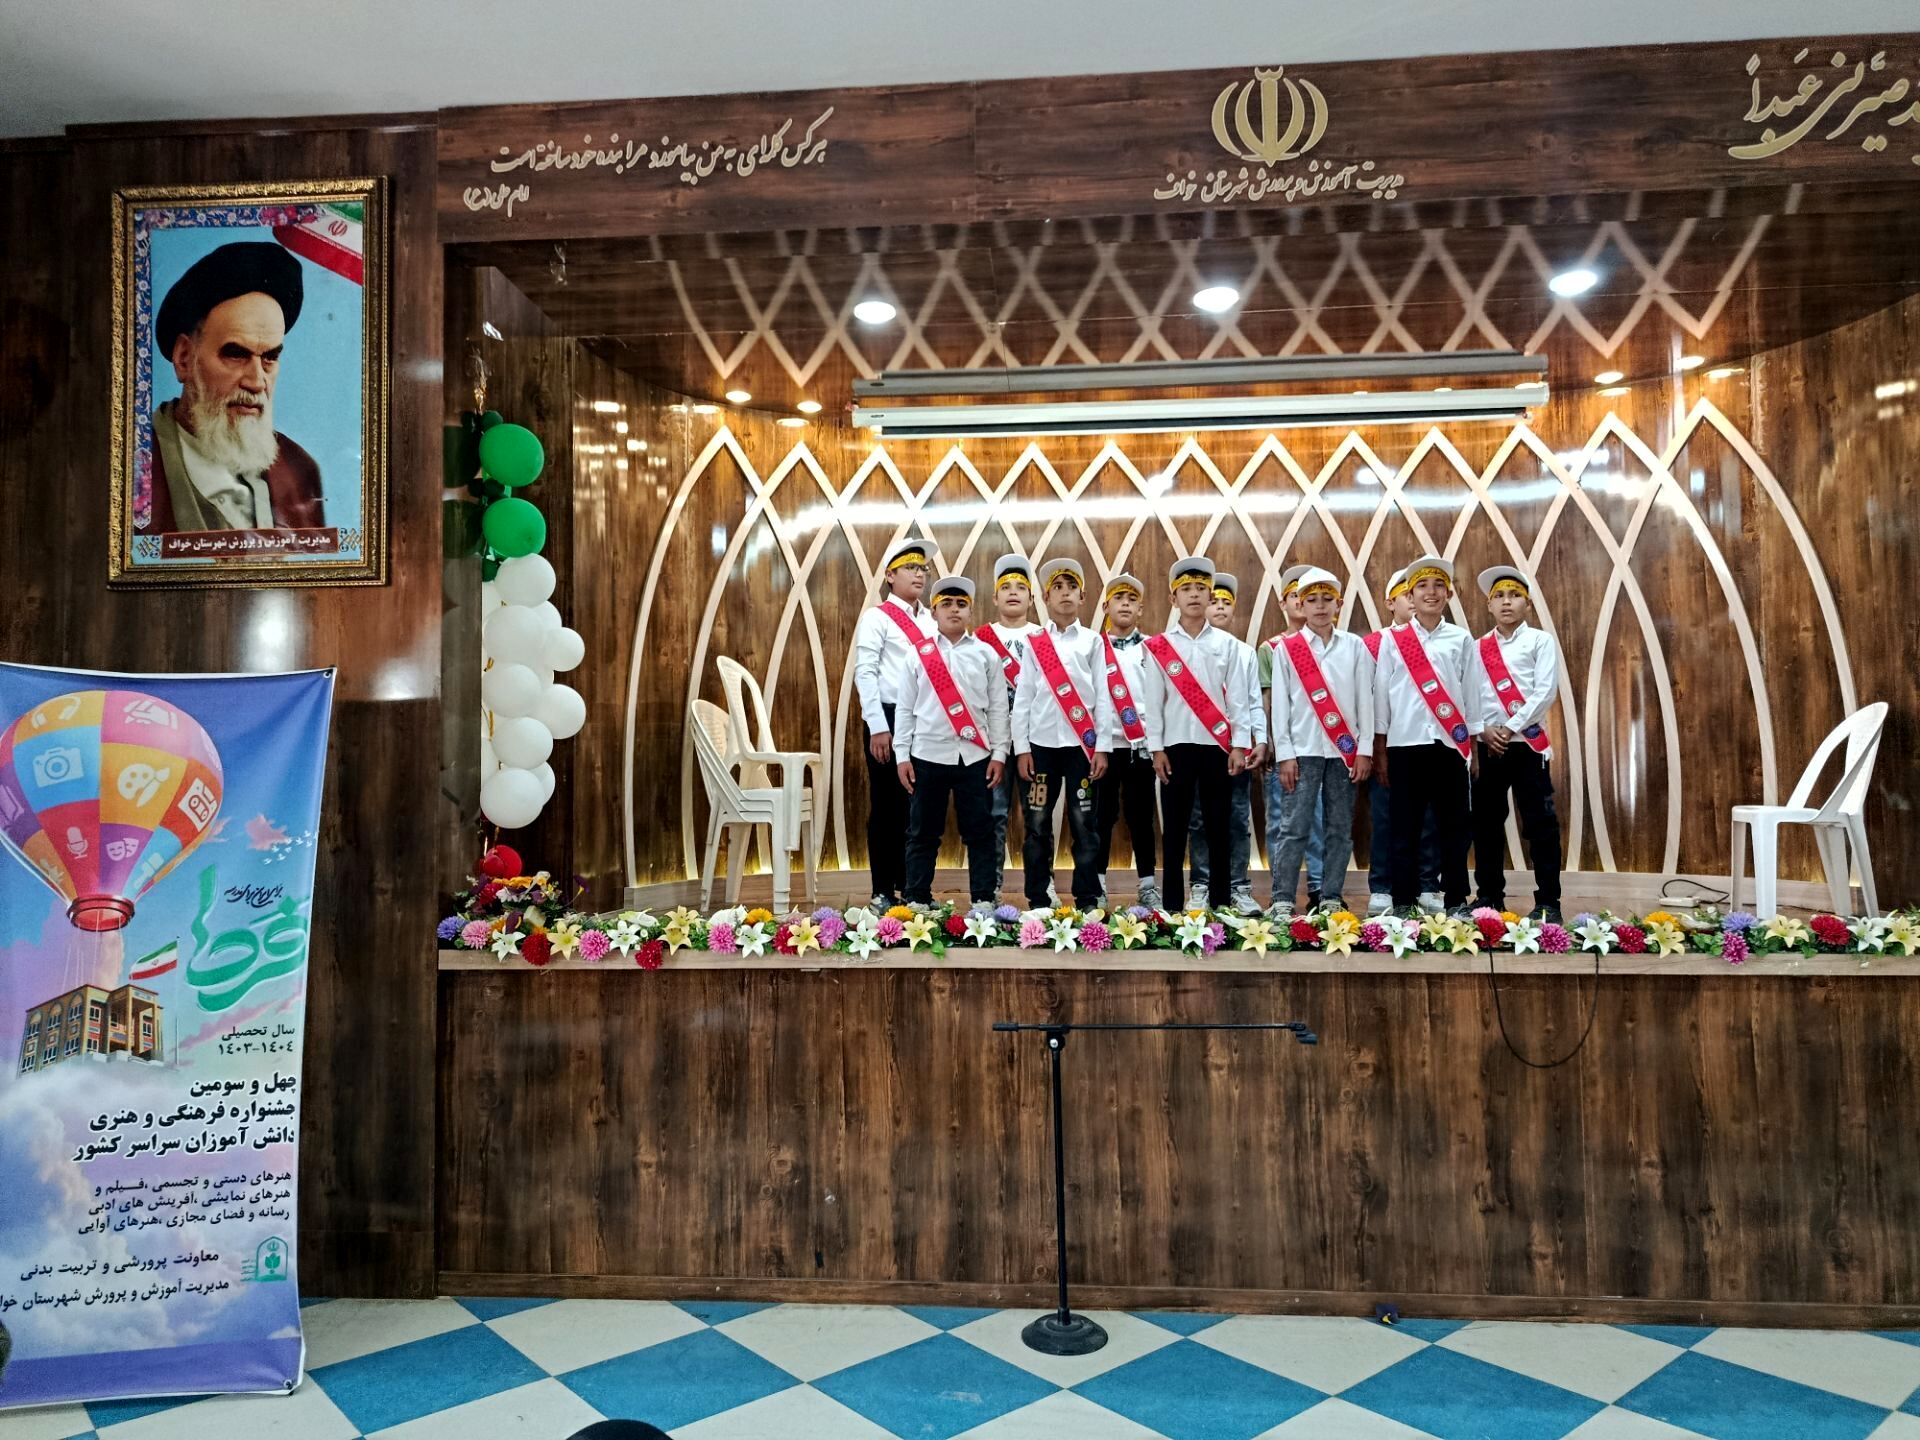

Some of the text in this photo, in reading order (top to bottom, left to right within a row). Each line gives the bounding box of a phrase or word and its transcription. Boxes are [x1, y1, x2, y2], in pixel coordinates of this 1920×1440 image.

[490, 148, 536, 173] است
[569, 134, 597, 170] خود
[626, 140, 648, 169] مرا
[696, 141, 725, 177] من
[1153, 170, 1198, 201] خواف
[1200, 167, 1249, 203] شهرستان
[1248, 167, 1296, 202] پرورش
[1302, 159, 1359, 196] آموزش
[1356, 160, 1405, 200] مدیریت
[507, 184, 530, 218] امام
[168, 533, 331, 552] مدیریت آموزش و پرورش شهرستان خواف
[221, 1024, 295, 1041] سال تحصیلی
[190, 1072, 296, 1097] چهل و سومین
[90, 1099, 295, 1131] جشنواره فرهنگی و هنری
[73, 1135, 122, 1161] کشور
[125, 1133, 181, 1157] سراسر
[185, 1126, 249, 1153] آموزان
[152, 1176, 199, 1192] تجسمی
[203, 1179, 209, 1189] و
[213, 1174, 247, 1188] دستی
[250, 1170, 292, 1186] هنرهای
[95, 1186, 102, 1197] و
[201, 1191, 246, 1207] نمایشی
[249, 1188, 291, 1204] هنرهای
[89, 1198, 115, 1215] ادبی
[119, 1197, 144, 1212] های
[210, 1207, 245, 1224] فضای
[248, 1211, 255, 1222] و
[258, 1206, 290, 1220] رسانه
[78, 1215, 110, 1234] آوایی
[166, 1212, 207, 1228] مجازی
[20, 1249, 219, 1281] معاونت پرورشی و تربیت بدنی
[0, 1278, 229, 1312] مدیریت آموزش و پرورش شهرستان خوا
